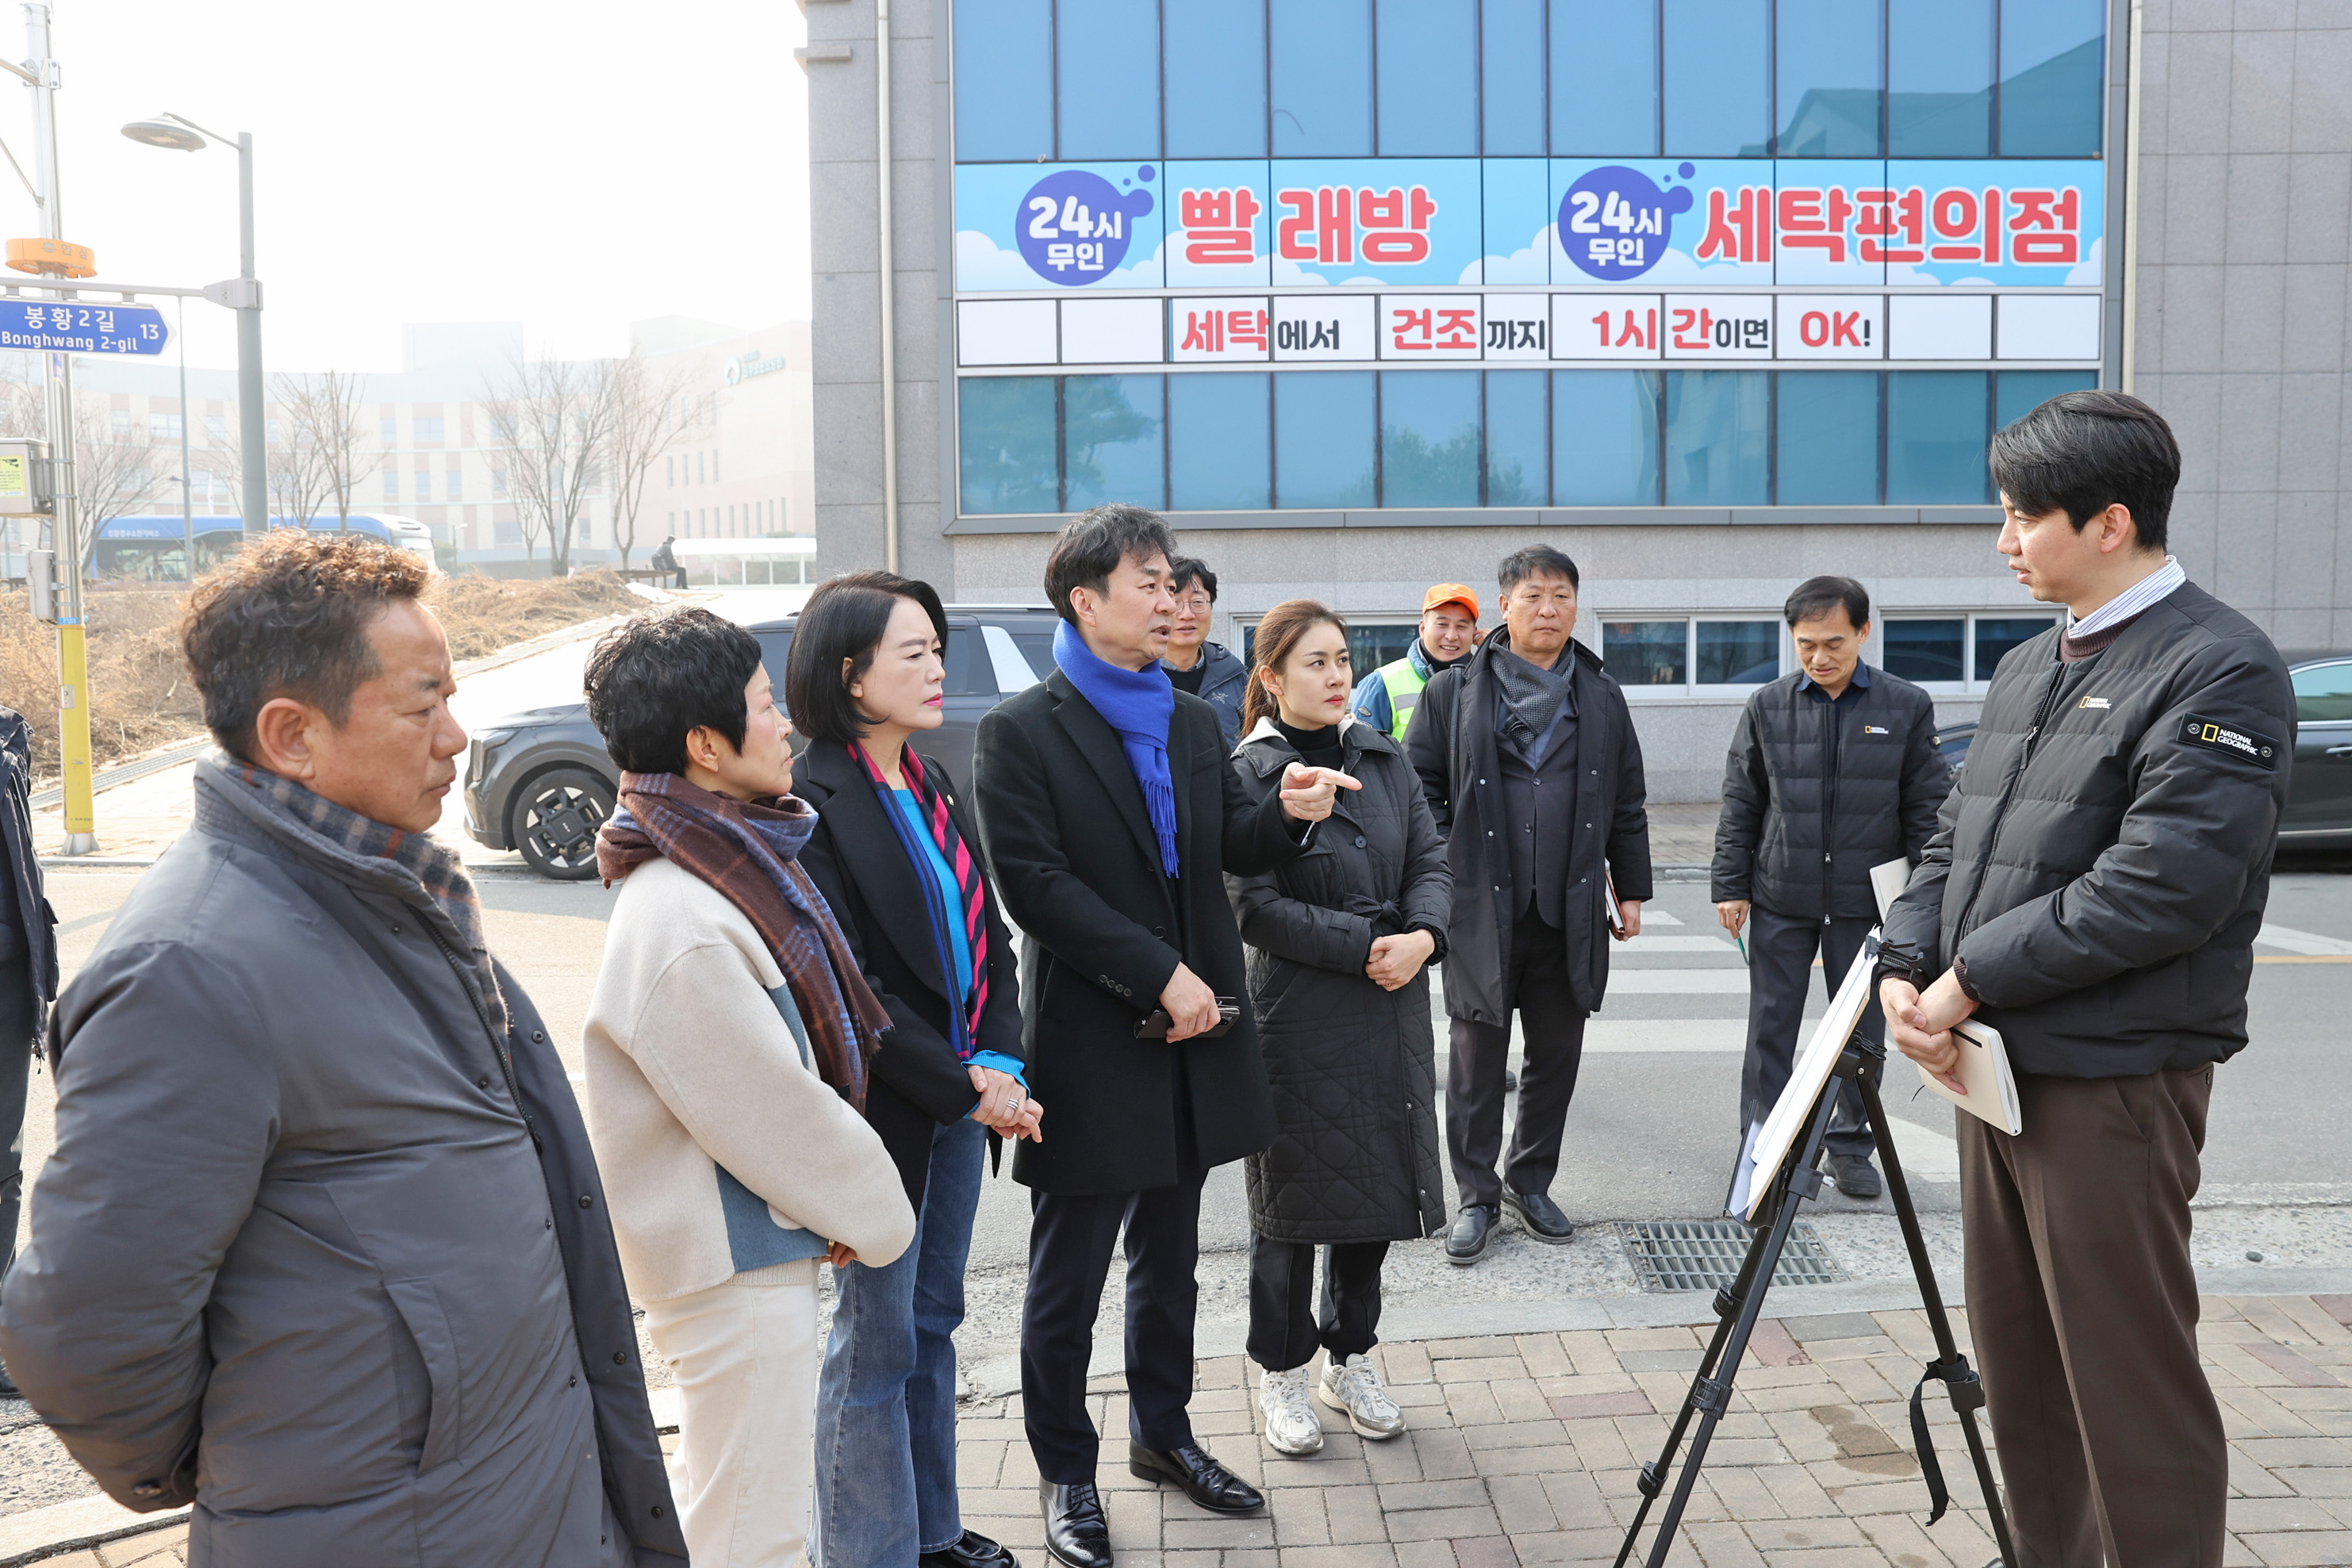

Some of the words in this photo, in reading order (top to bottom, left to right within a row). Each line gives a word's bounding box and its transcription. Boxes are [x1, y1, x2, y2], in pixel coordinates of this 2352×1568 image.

[1028, 195, 1122, 240] 24시
[1180, 187, 1437, 265] 빨래방
[1570, 190, 1663, 236] 24시
[1696, 187, 2078, 263] 세탁편의점
[1046, 242, 1104, 271] 무인
[1588, 237, 1644, 266] 무인
[24, 306, 114, 332] 봉황2길
[140, 324, 159, 339] 13
[1800, 311, 1870, 347] OK!
[2, 331, 94, 351] Bonghwang
[101, 336, 138, 352] 2-gil
[2217, 735, 2258, 755] GEOGRAPHIC
[2219, 729, 2252, 746] NATIONAL
